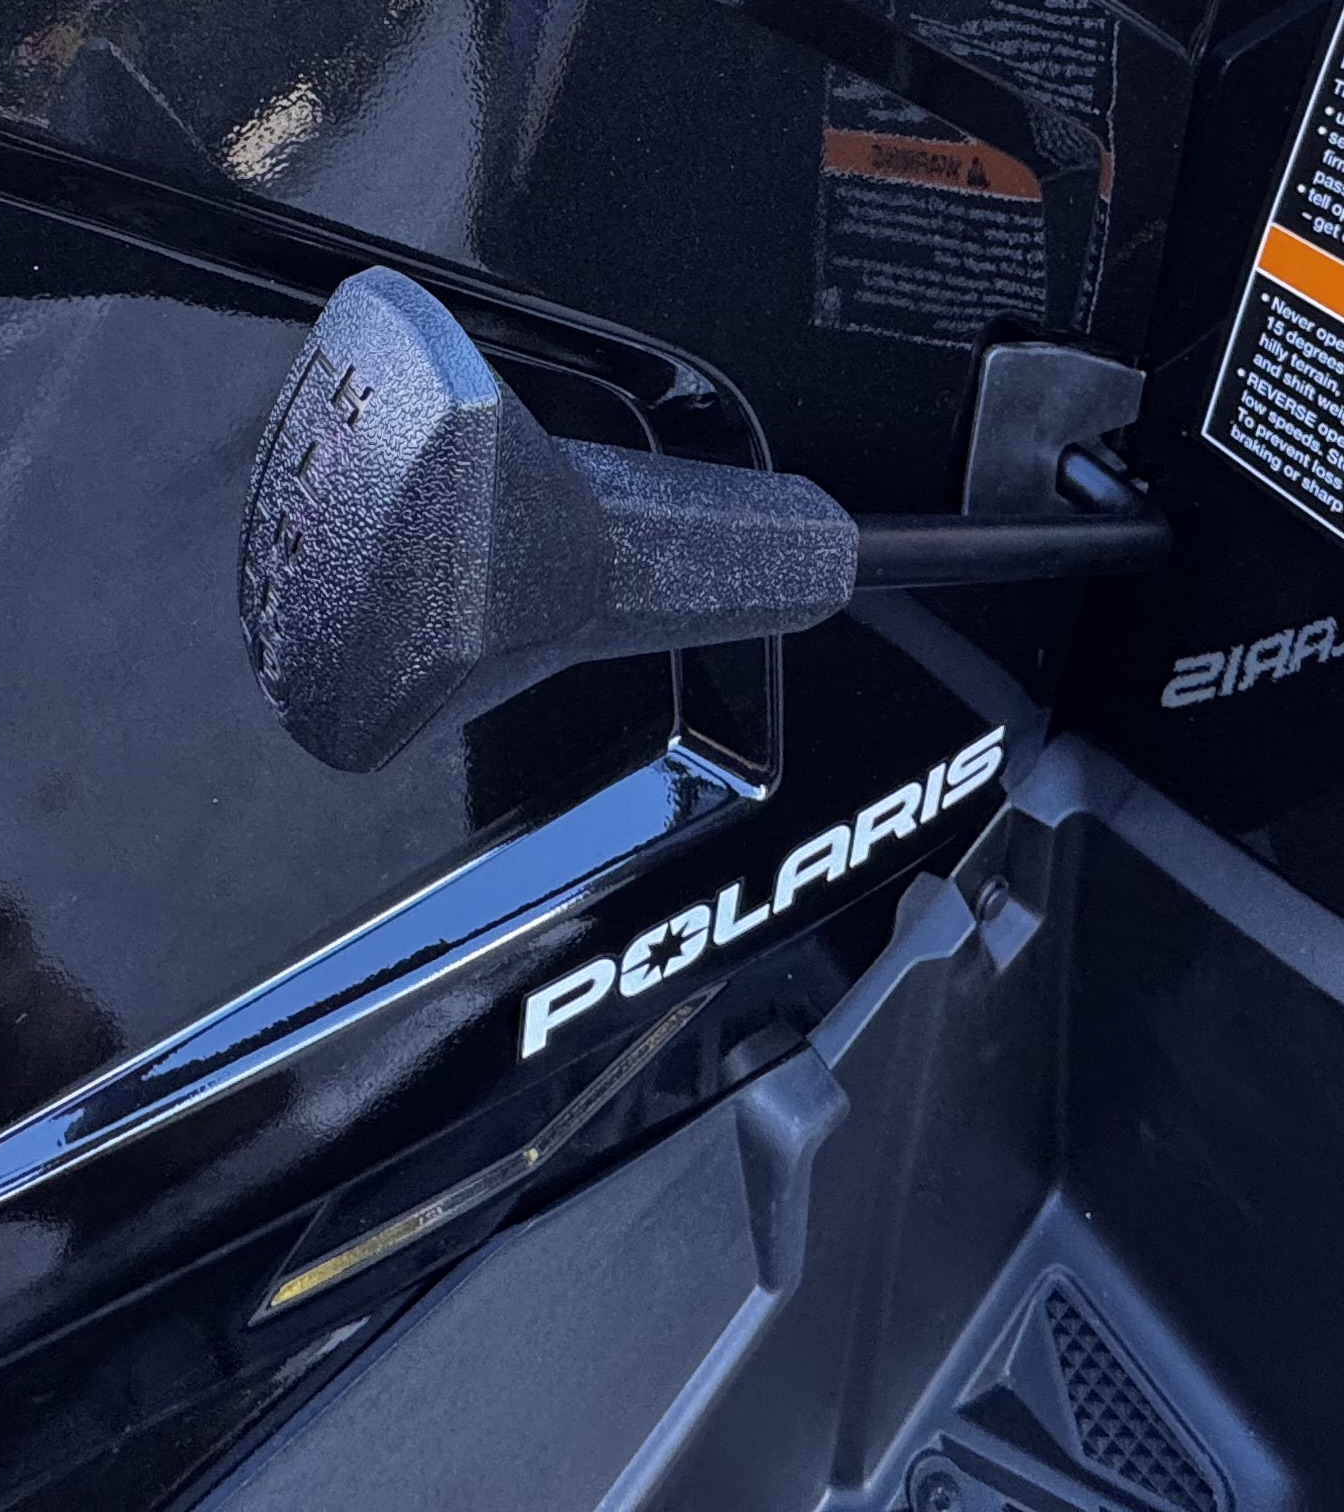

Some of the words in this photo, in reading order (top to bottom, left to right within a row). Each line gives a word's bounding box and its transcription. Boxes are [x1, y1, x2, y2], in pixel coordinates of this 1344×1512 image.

[1307, 187, 1332, 210] tell
[1312, 216, 1341, 239] get
[1267, 316, 1285, 336] 15
[1270, 296, 1316, 332] Never
[1252, 353, 1283, 379] and
[1282, 372, 1316, 401] shift
[1258, 332, 1289, 362] hilly
[1290, 353, 1341, 397] terrain,
[1240, 390, 1268, 416] low
[1267, 410, 1324, 456] speeds.
[1246, 371, 1318, 429] REVERSE
[1230, 423, 1283, 472] braking
[1283, 464, 1301, 482] or
[1301, 476, 1344, 513] sharp
[1237, 406, 1255, 429] To
[1255, 423, 1311, 468] prevent
[1311, 459, 1343, 490] loss
[520, 726, 1007, 1059] POLARIS
